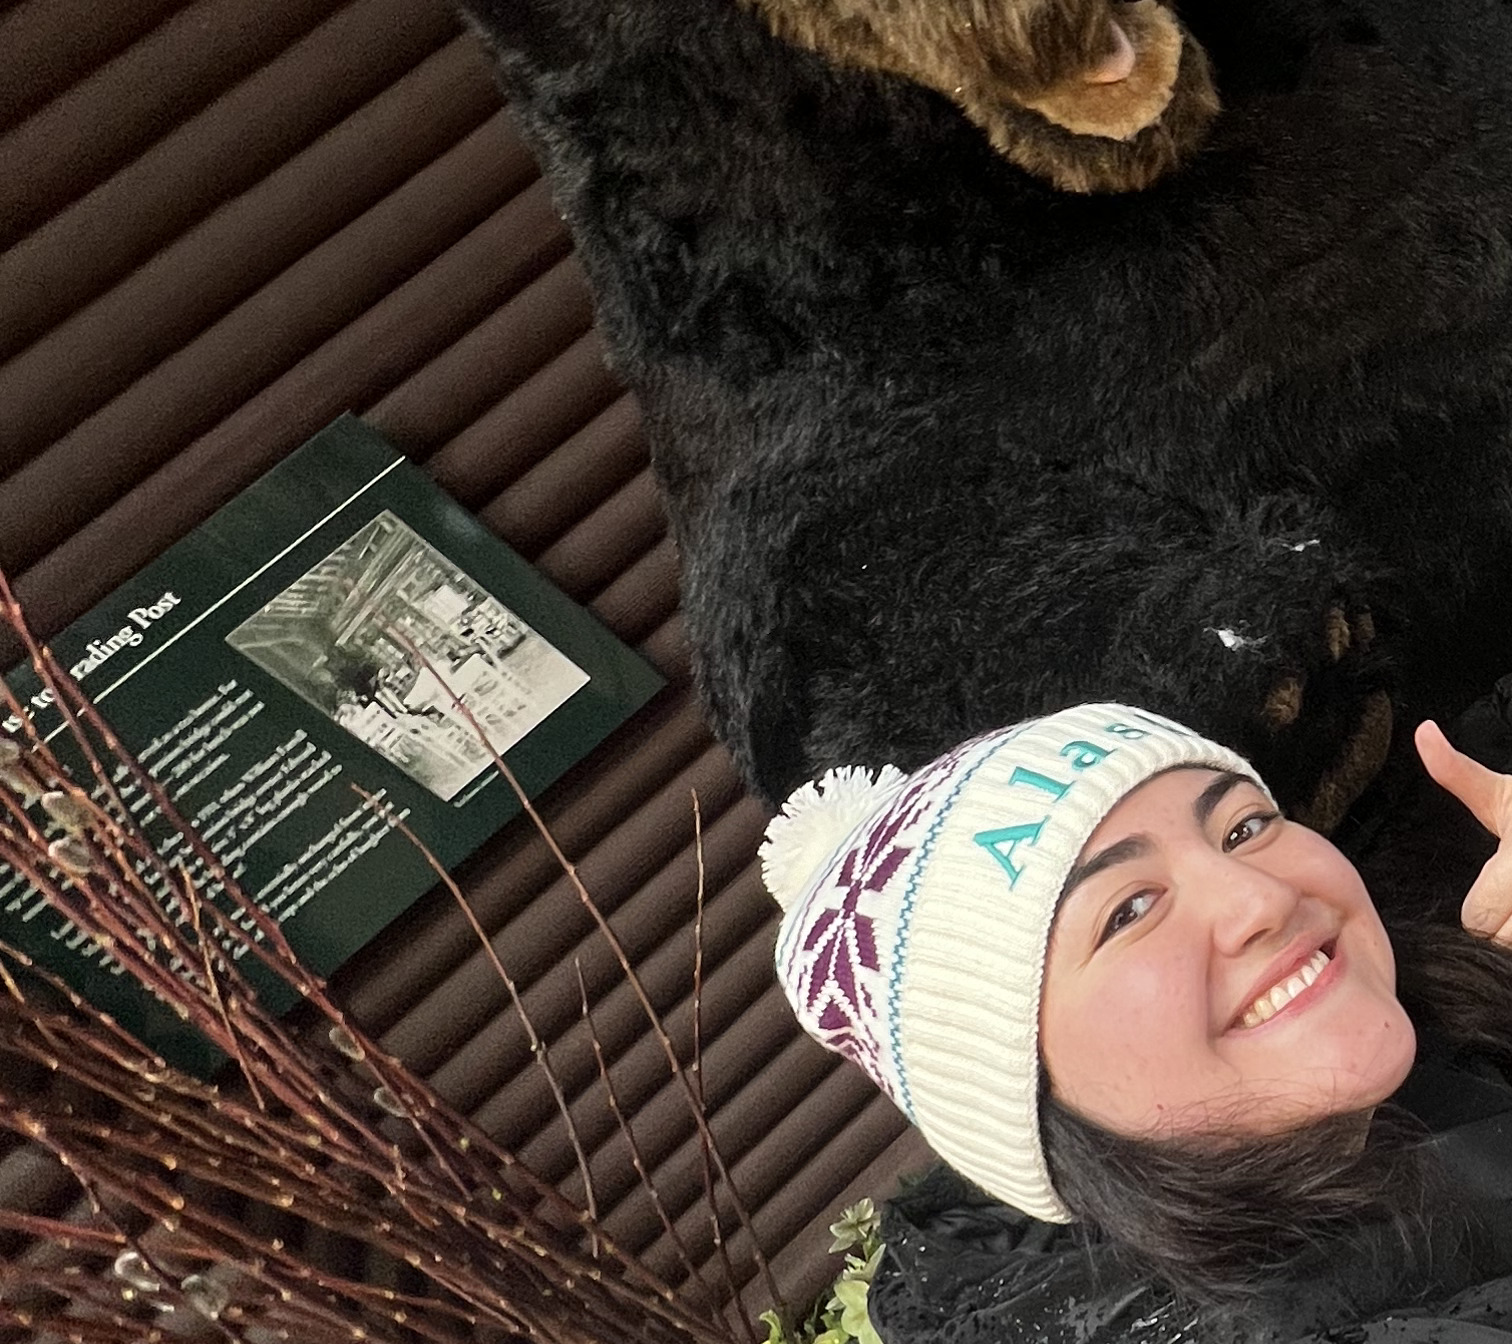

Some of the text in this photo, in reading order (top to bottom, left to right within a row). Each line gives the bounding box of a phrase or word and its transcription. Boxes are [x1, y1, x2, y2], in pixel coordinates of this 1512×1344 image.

[69, 625, 144, 681] rading
[127, 591, 182, 630] Post
[973, 714, 1190, 891] Alas
